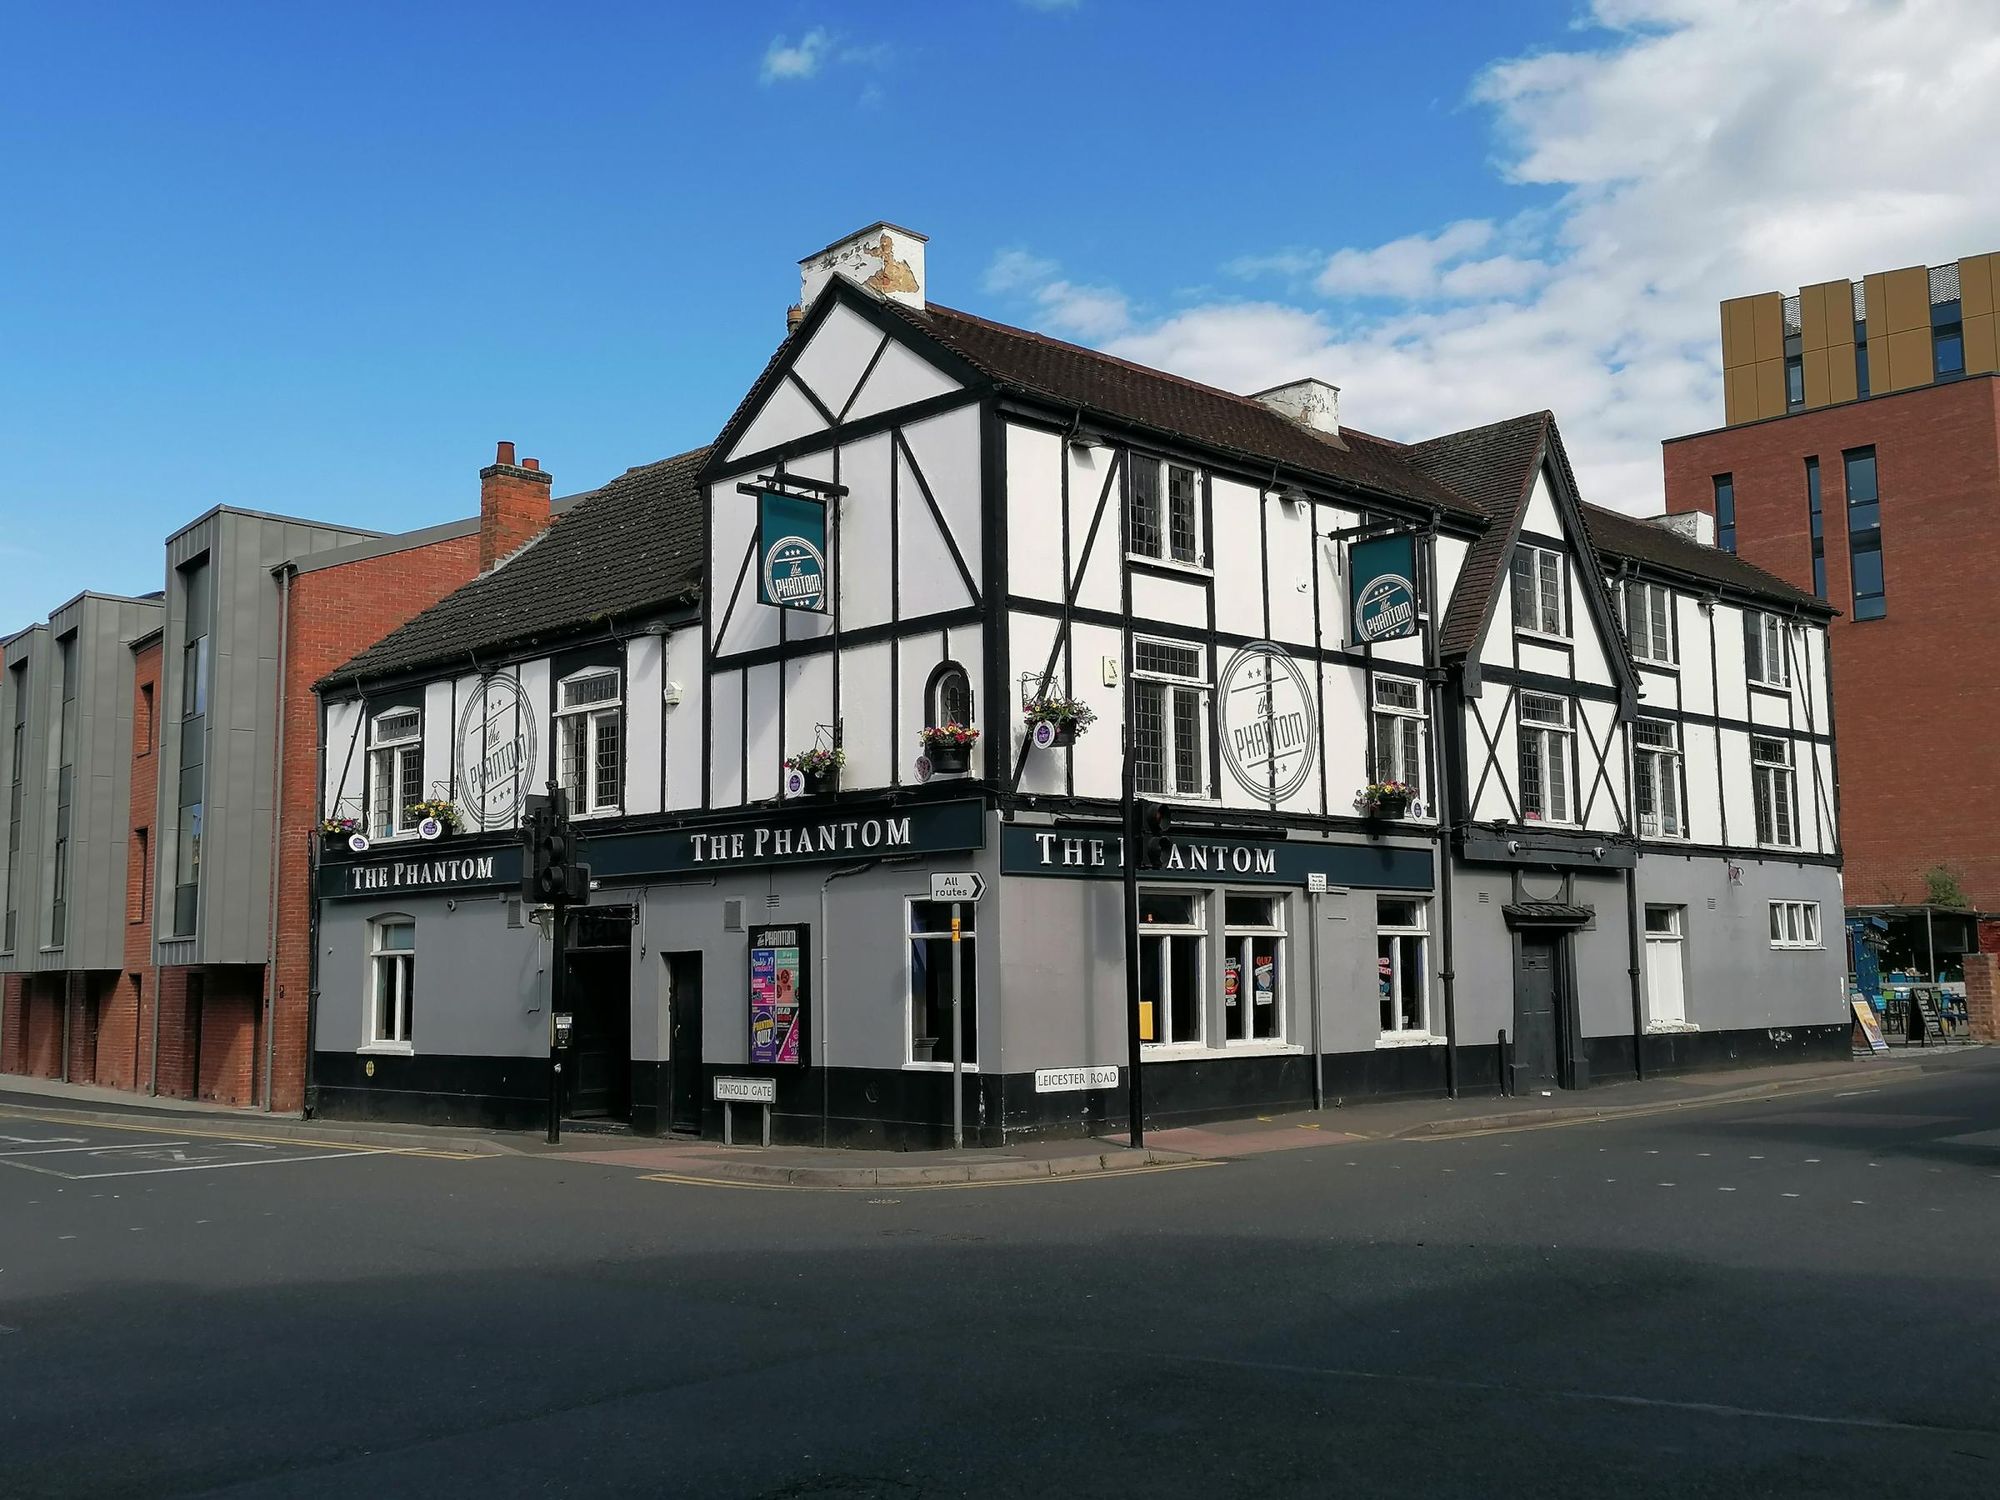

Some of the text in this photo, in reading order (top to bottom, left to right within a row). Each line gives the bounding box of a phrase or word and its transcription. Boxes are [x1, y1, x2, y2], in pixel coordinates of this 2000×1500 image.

[790, 562, 802, 575] the
[776, 574, 821, 597] PHANTOM
[1380, 598, 1391, 611] the
[1366, 601, 1411, 635] PHANTOM
[1256, 691, 1274, 717] the
[487, 721, 501, 749] the
[1234, 712, 1305, 761] PHANTOM
[470, 733, 528, 794] PHANTOM
[690, 817, 911, 862] THE PHANTOM
[1035, 833, 1277, 874] THE ANTOM
[352, 856, 494, 889] THE PHANTOM
[944, 877, 959, 886] All
[935, 888, 968, 896] routes
[764, 930, 796, 946] PHANTOM
[756, 1028, 771, 1046] QUIZ
[719, 1084, 772, 1096] PINFOLD GATE
[1038, 1071, 1117, 1087] LEICESTER ROAD
